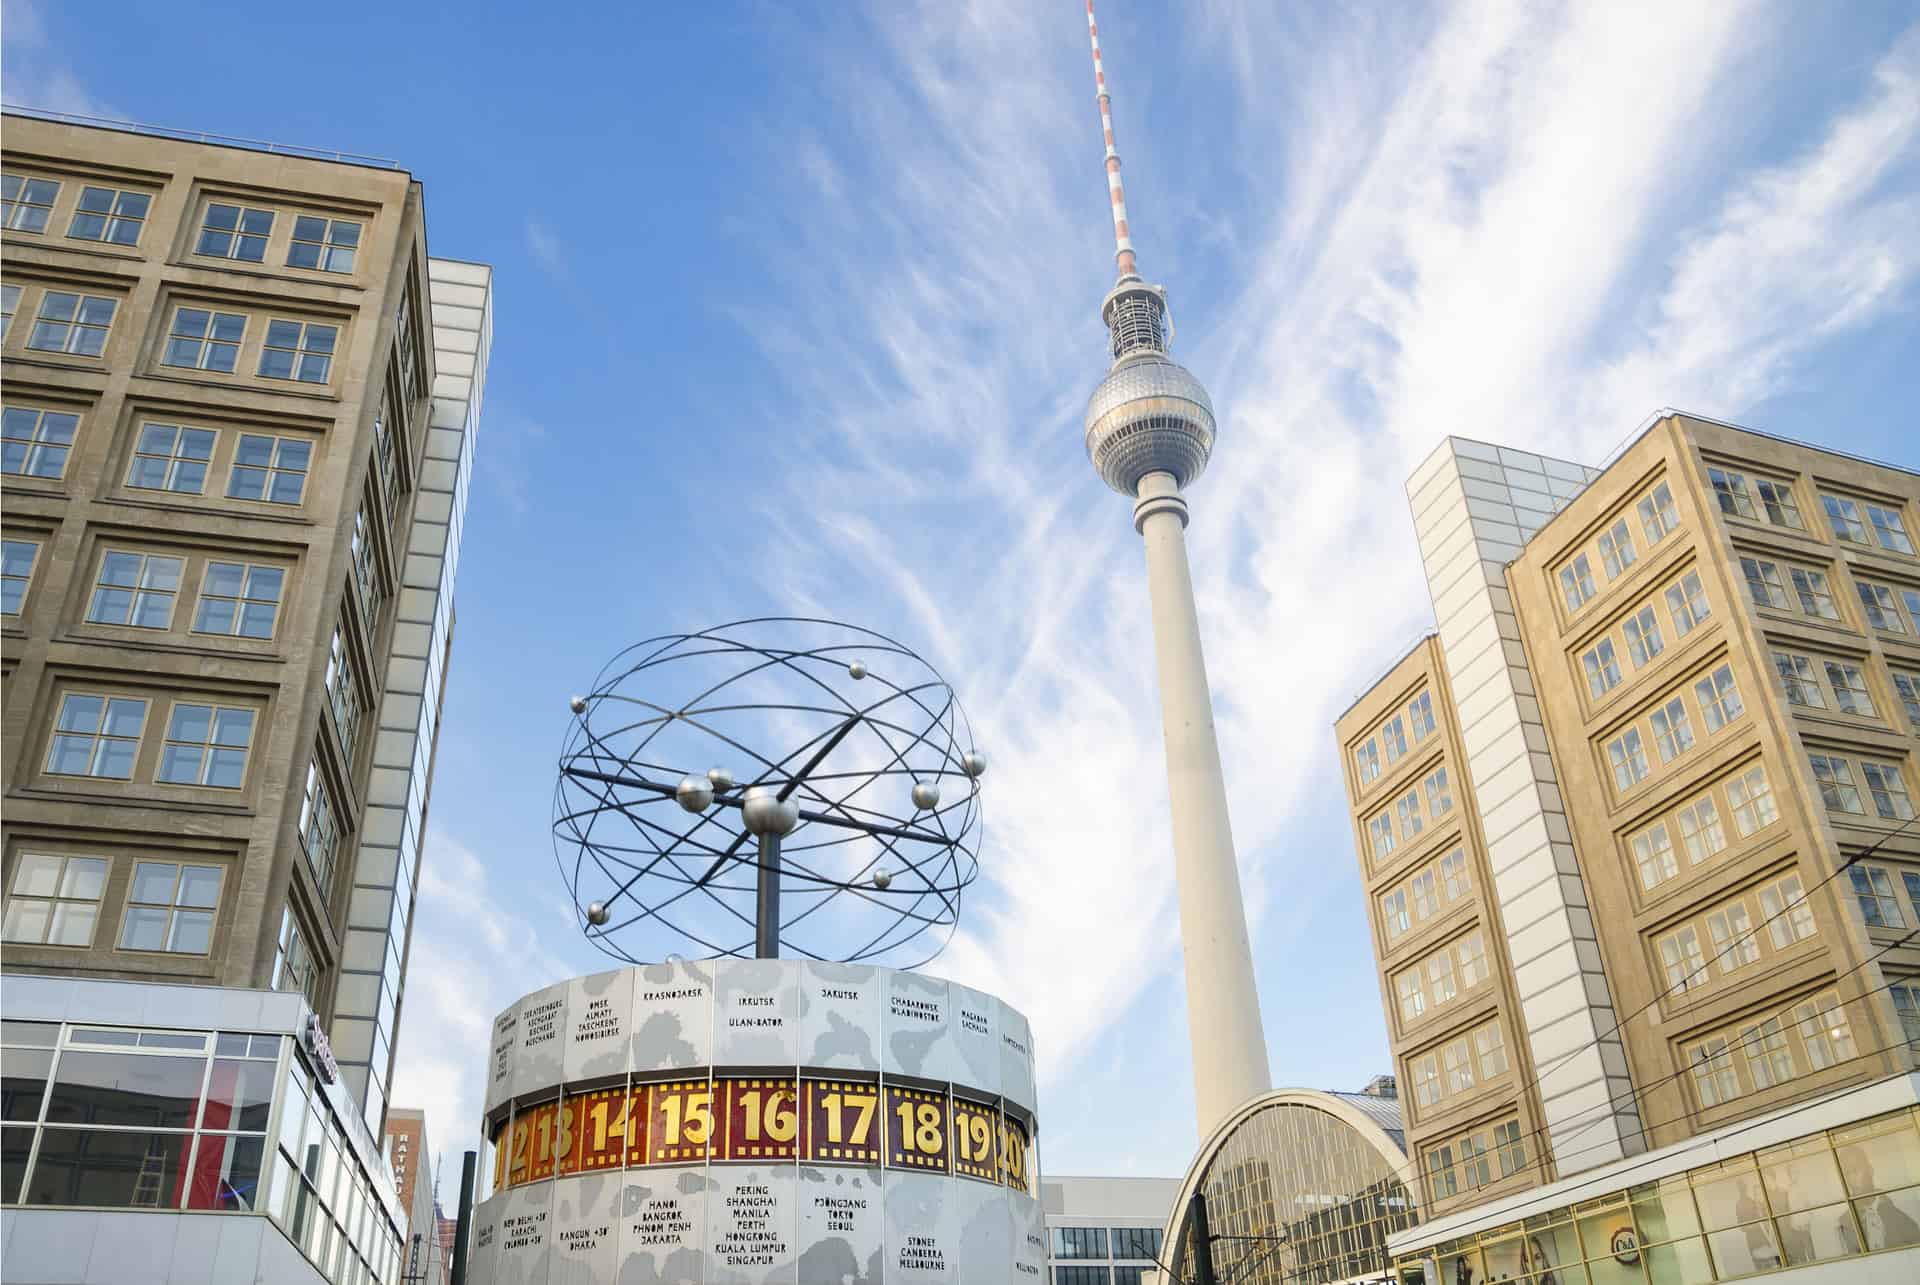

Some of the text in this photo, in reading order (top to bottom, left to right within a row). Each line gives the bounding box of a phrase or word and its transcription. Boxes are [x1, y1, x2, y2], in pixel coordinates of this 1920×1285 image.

[644, 989, 703, 1000] KRASNOJARSK
[822, 989, 858, 1000] JAKUTSK
[738, 997, 775, 1007] IRKUTSK
[729, 1018, 783, 1027] ULAN-BATOR
[660, 1091, 715, 1145] 15
[739, 1089, 798, 1143] 16
[821, 1093, 878, 1144] 17
[590, 1097, 638, 1151] 14
[896, 1102, 943, 1154] 18
[537, 1107, 574, 1161] 13
[955, 1112, 990, 1162] 19
[735, 1186, 769, 1195] PEKING
[648, 1199, 677, 1210] HANOI
[726, 1198, 777, 1207] SHANGHAI
[642, 1211, 683, 1222] BANGKOK
[733, 1209, 770, 1218] MANILA
[827, 1210, 854, 1220] TOKYO
[632, 1222, 692, 1234] PHNOM PENH
[737, 1221, 766, 1230] PERTH
[827, 1222, 855, 1231] SEOUL
[560, 1230, 590, 1241] RANGUN
[641, 1234, 682, 1245] JAKARTA
[726, 1232, 777, 1241] HONGKONG
[570, 1240, 597, 1251] DHAKA
[907, 1236, 936, 1247] SYDNEY
[715, 1243, 786, 1254] KUALA LUMPUR
[900, 1247, 944, 1258] CANBERRA
[727, 1256, 774, 1265] SINGAPUR
[899, 1258, 945, 1270] MELBOURNE
